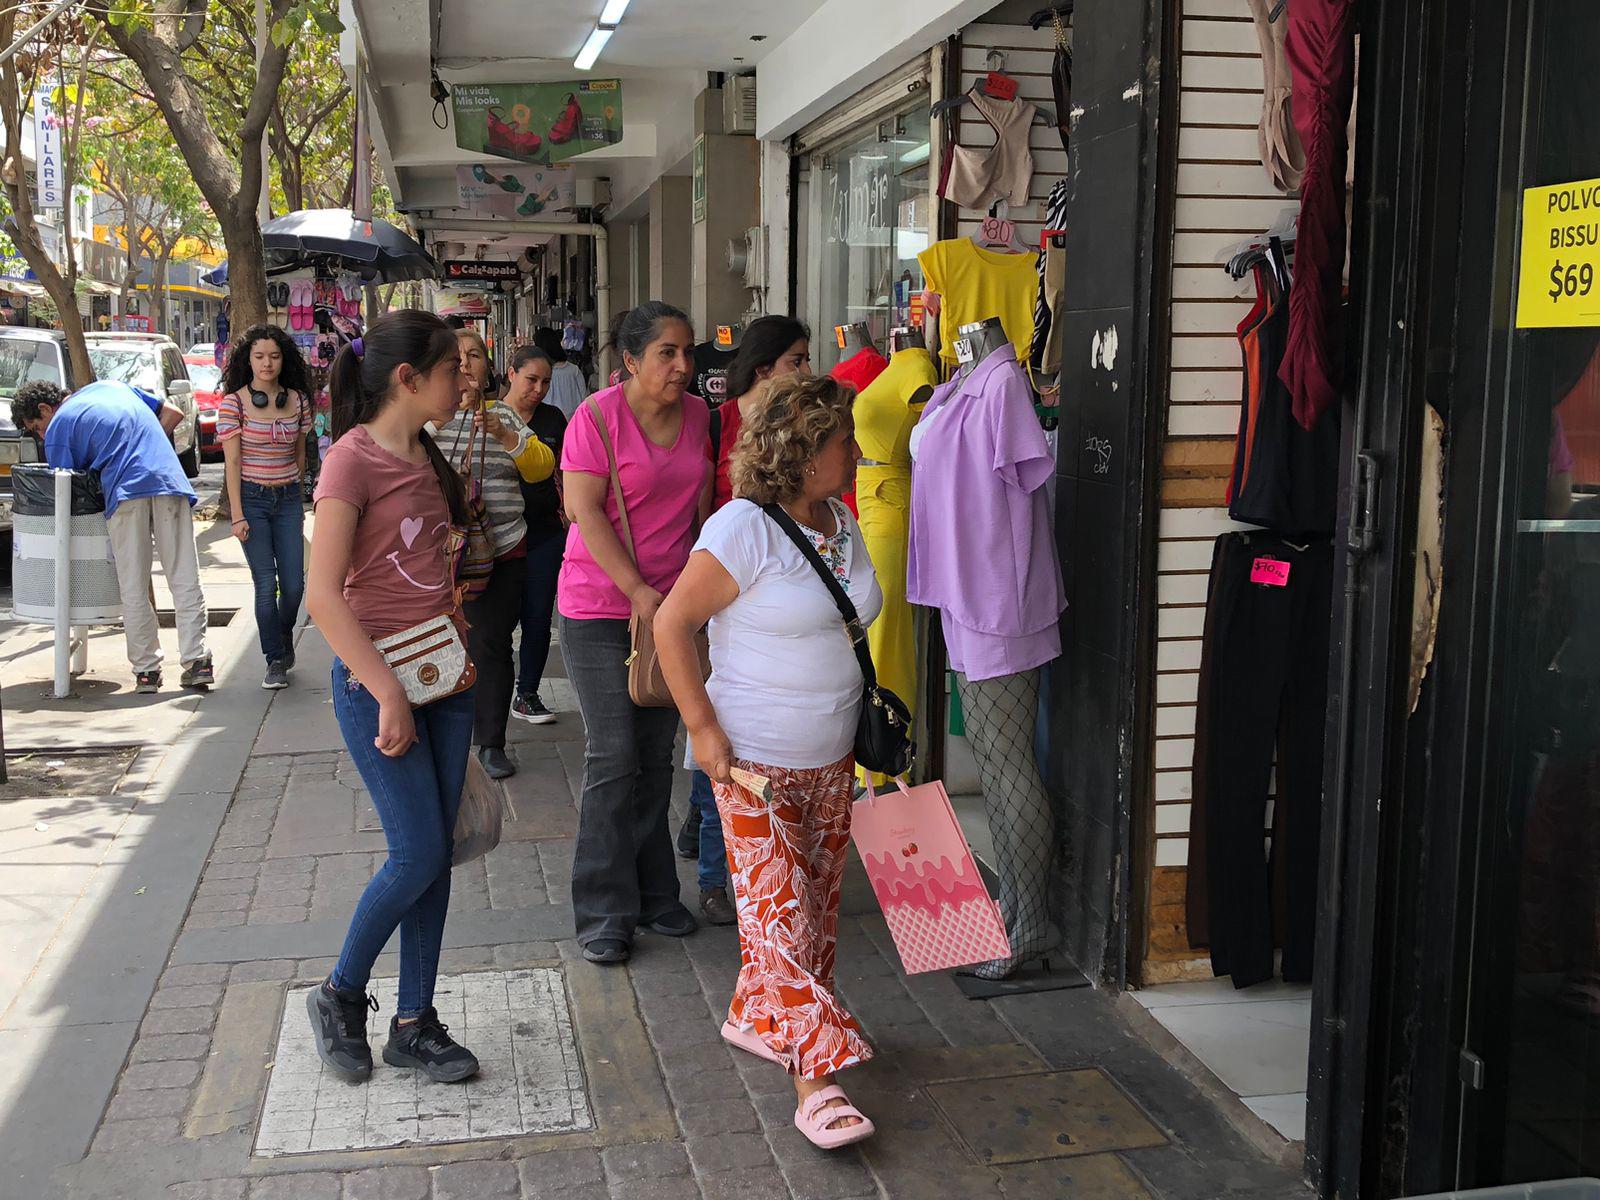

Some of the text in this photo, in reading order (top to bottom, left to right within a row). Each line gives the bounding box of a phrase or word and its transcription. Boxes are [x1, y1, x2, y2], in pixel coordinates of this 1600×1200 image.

[454, 86, 490, 95] Mi vida
[455, 96, 500, 105] Mis looks
[41, 96, 55, 202] SIMILARES
[983, 219, 1010, 243] $80
[1550, 223, 1600, 248] BISSU
[1549, 259, 1593, 303] $69
